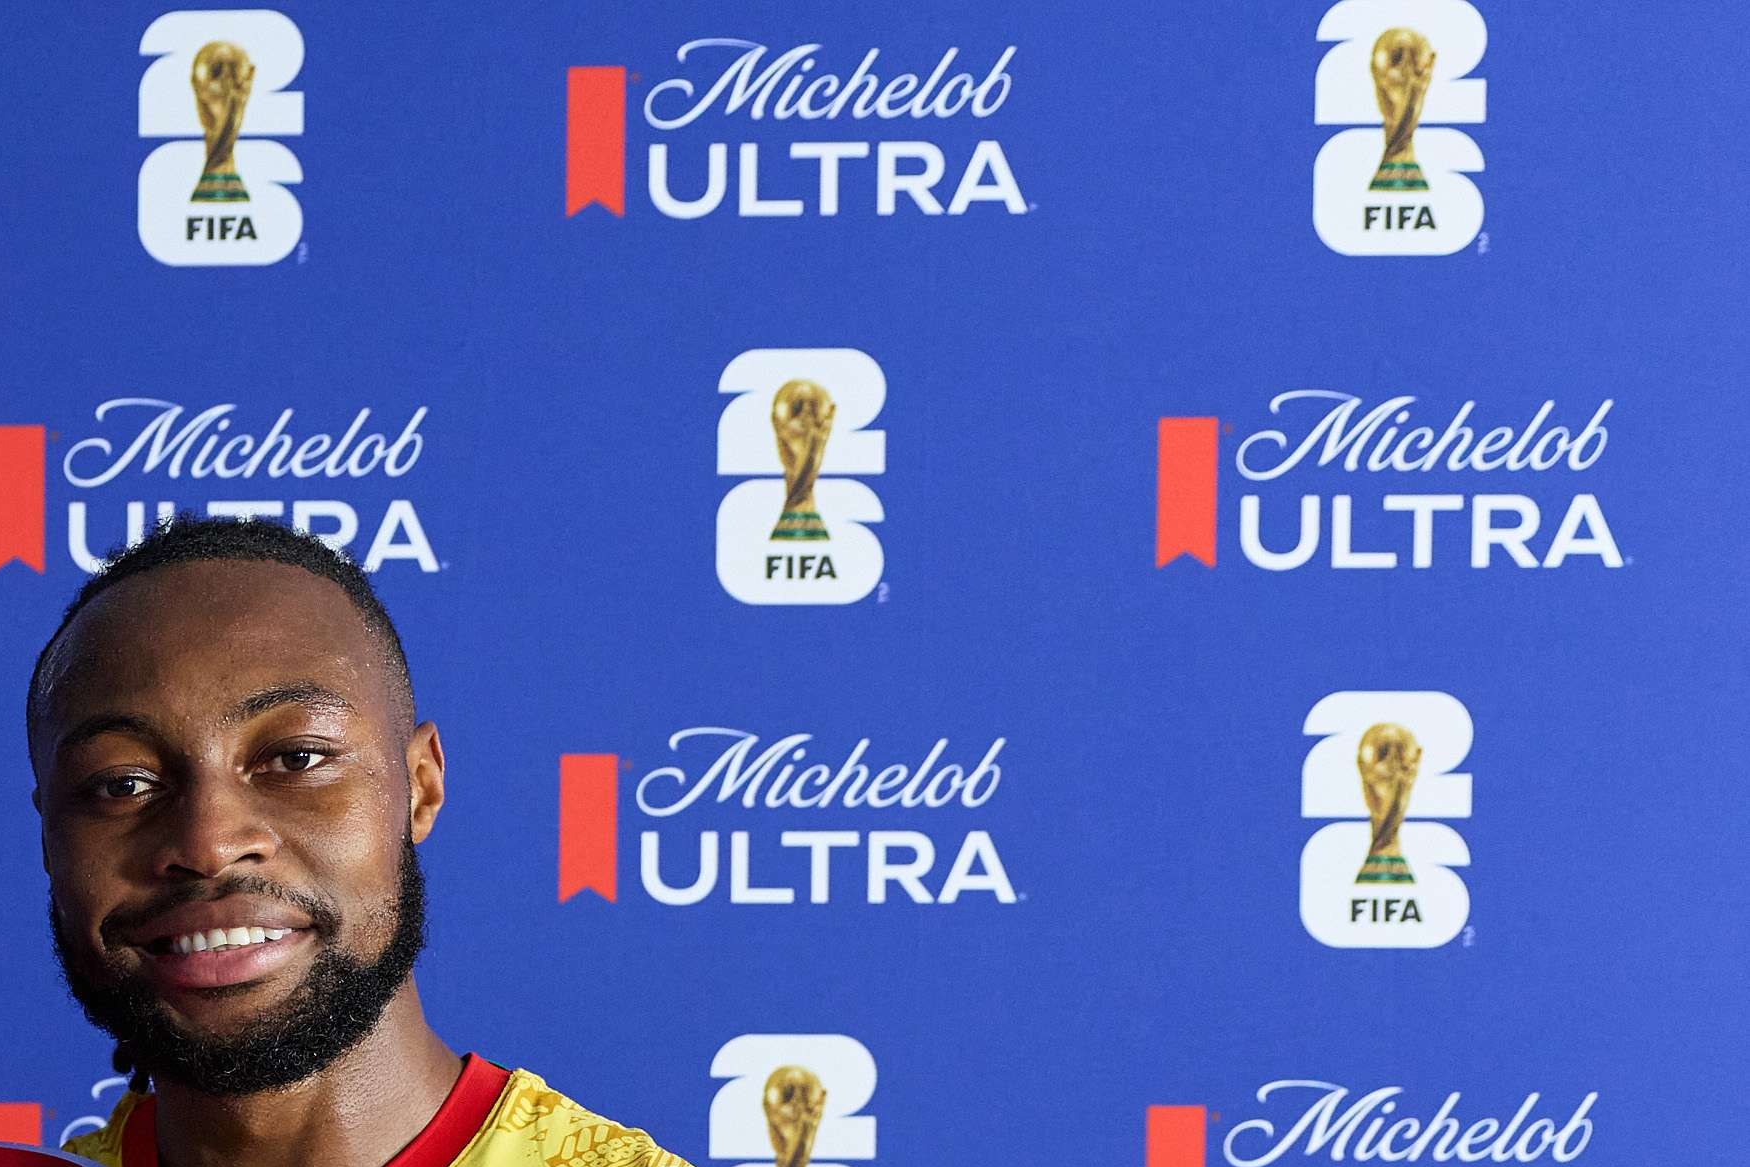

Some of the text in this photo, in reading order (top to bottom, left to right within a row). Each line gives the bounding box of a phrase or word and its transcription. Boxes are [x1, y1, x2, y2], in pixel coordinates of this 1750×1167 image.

[643, 37, 1017, 130] Michelob
[648, 139, 1029, 220] ULTRA
[1364, 206, 1436, 230] FIFA
[186, 216, 258, 241] FIFA
[63, 397, 428, 488] Michelob
[1235, 389, 1614, 481] Michelob
[766, 555, 837, 580] FIFA
[1239, 493, 1624, 572] ULTRA
[635, 726, 1007, 817] Michelob
[640, 830, 1018, 906] ULTRA
[1351, 898, 1422, 923] FIFA
